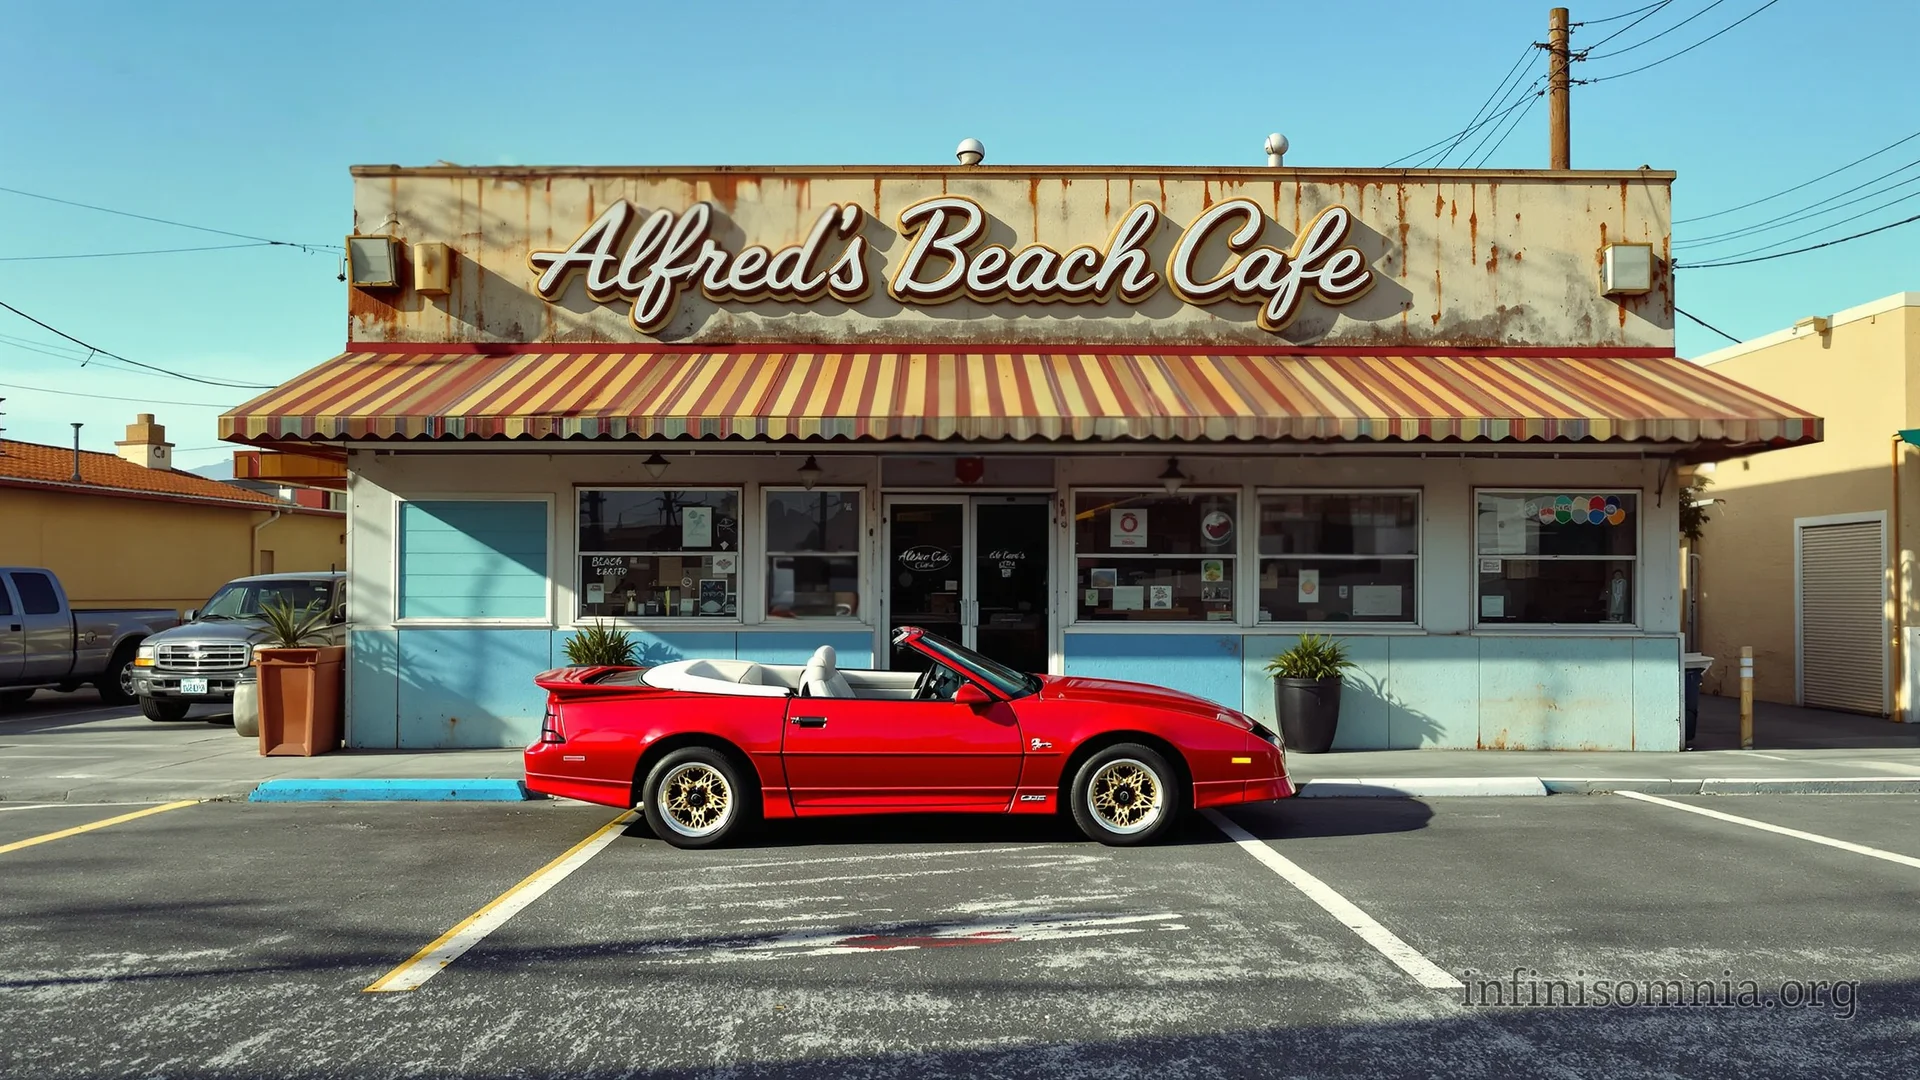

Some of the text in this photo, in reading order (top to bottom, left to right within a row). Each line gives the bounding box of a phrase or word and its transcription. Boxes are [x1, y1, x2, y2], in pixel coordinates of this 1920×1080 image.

[529, 196, 1374, 329] Alfred's Beach Cafe
